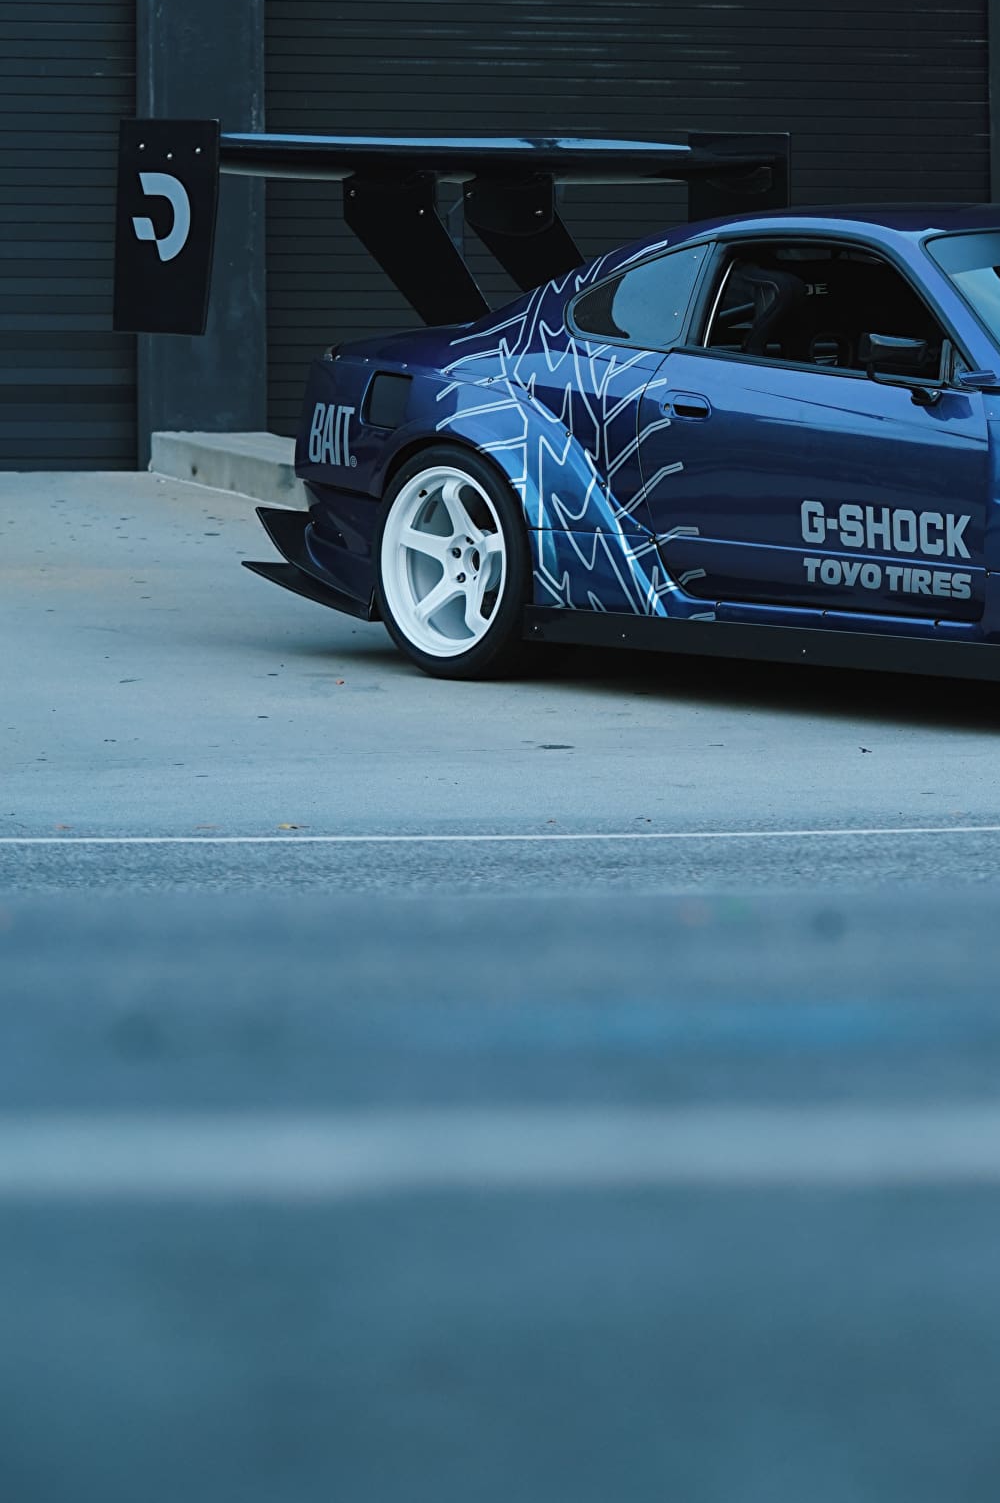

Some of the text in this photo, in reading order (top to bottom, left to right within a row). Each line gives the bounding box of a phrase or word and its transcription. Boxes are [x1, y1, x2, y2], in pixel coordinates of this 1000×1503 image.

[309, 402, 355, 467] BAIT
[801, 500, 972, 559] G-SHOCK
[803, 557, 972, 600] TOYO TIRES
